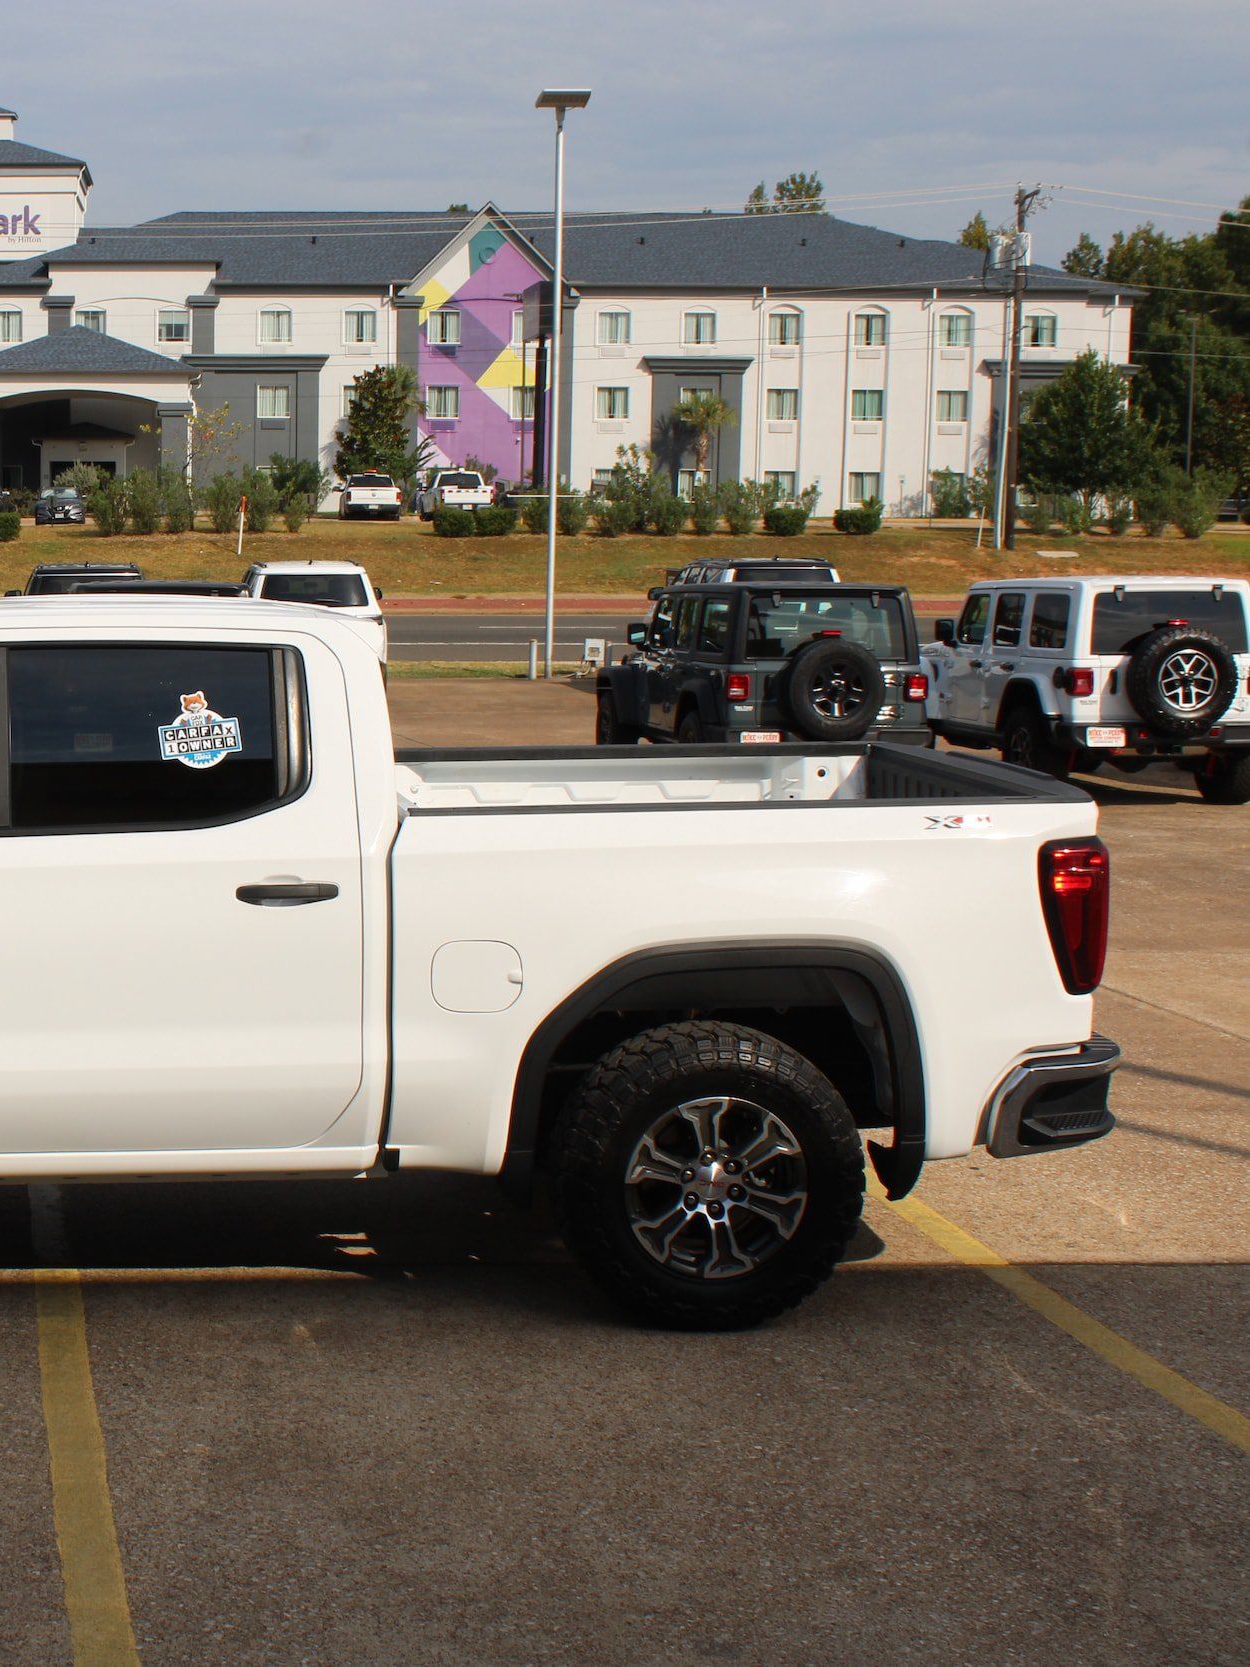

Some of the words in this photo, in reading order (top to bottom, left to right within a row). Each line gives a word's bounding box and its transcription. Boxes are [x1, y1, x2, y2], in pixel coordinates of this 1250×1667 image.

[17, 235, 41, 243] Hilton
[164, 724, 234, 742] CARFAX
[168, 744, 175, 753] 1
[178, 736, 236, 753] OWNER
